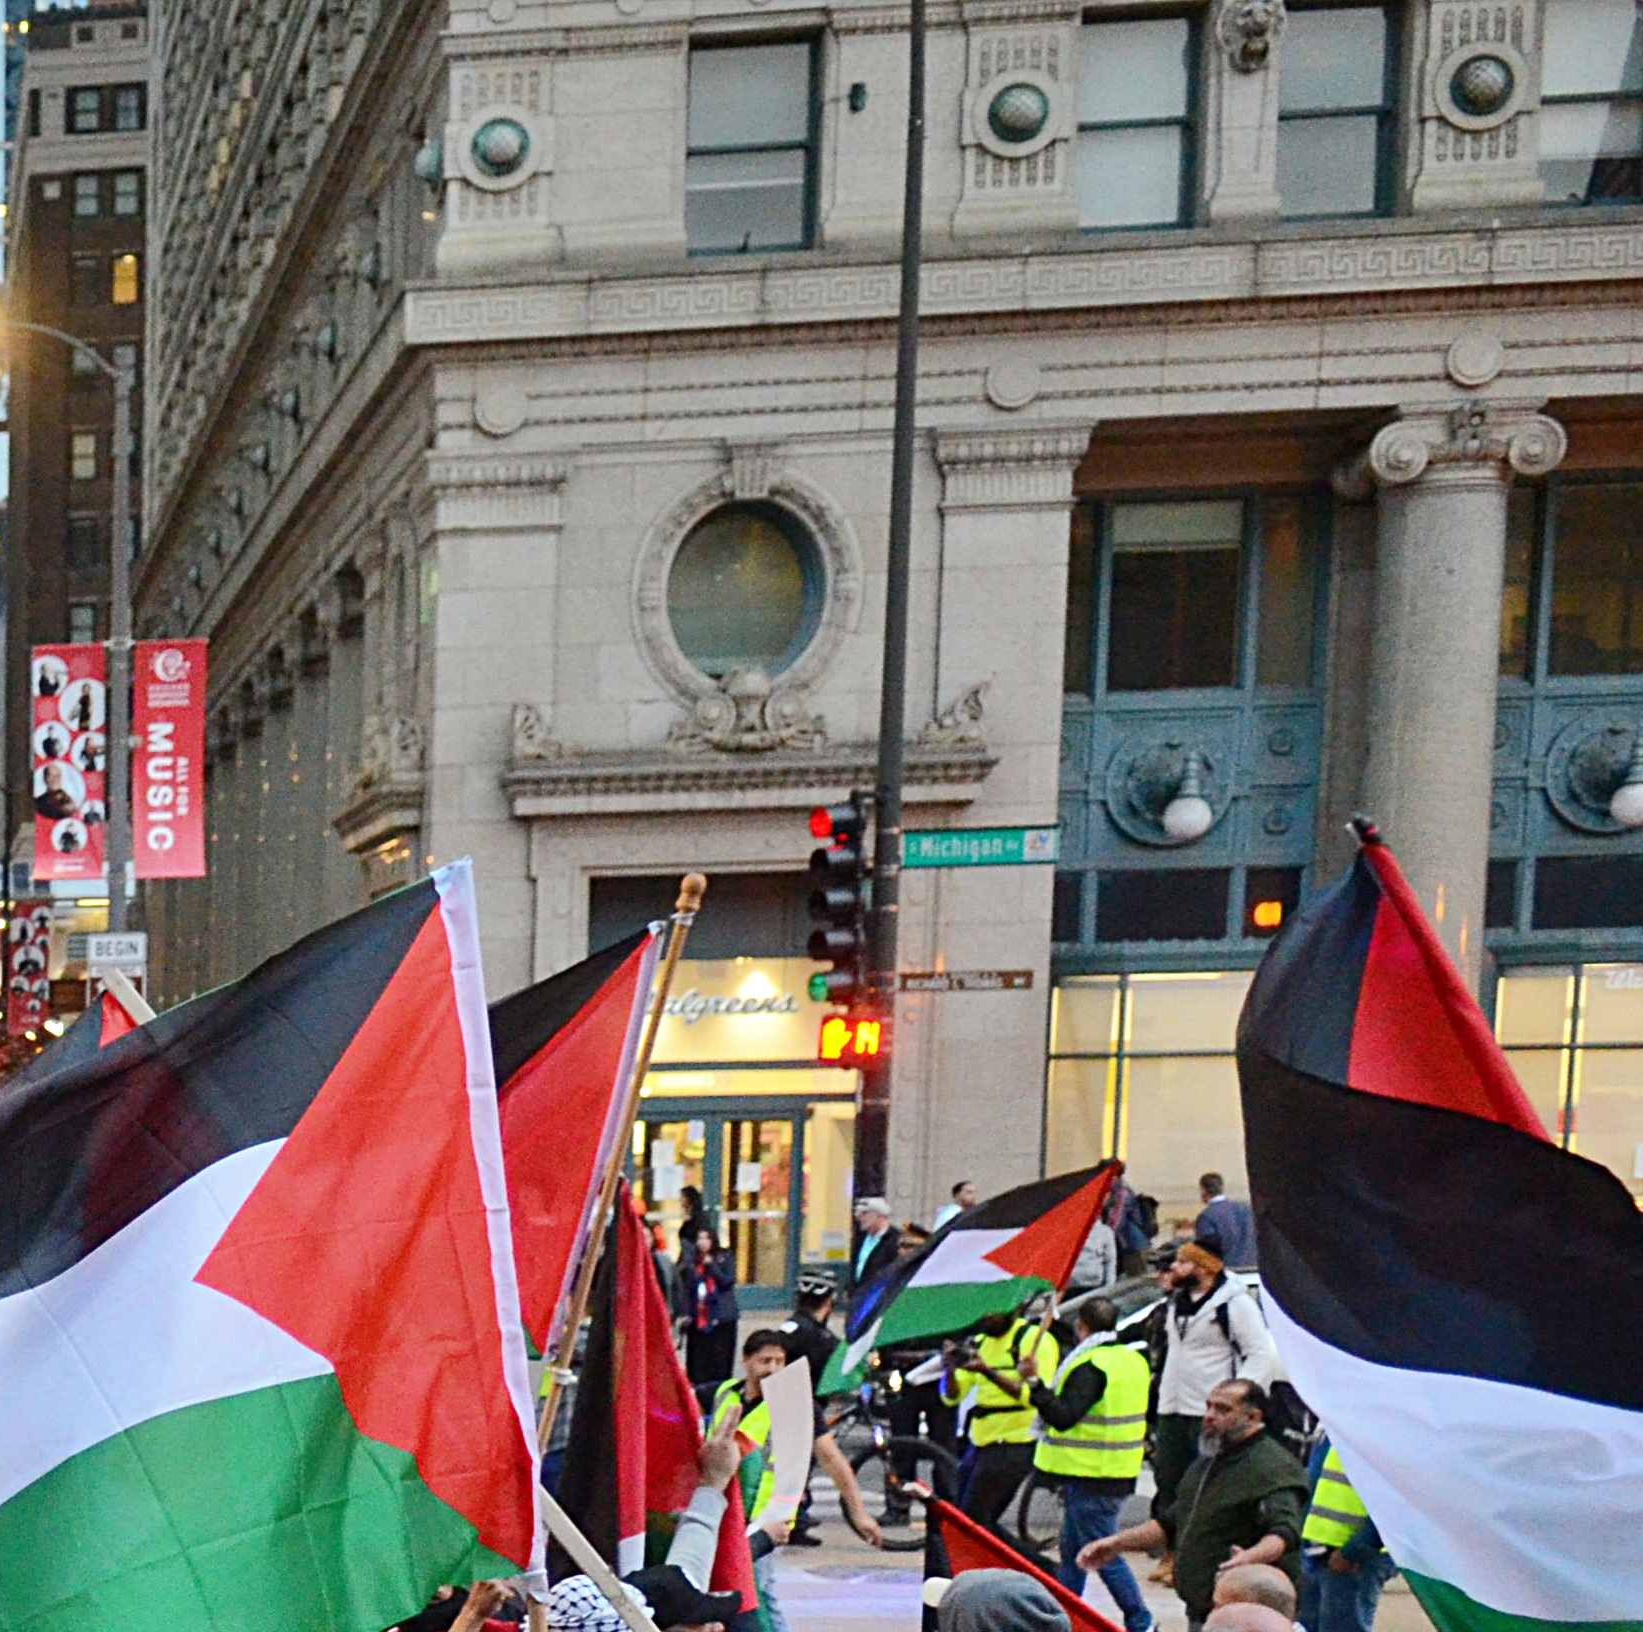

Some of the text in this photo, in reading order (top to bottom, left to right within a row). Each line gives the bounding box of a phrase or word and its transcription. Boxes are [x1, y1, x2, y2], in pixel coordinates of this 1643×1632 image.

[147, 721, 175, 851] MUSIC
[920, 834, 1003, 863] Michigan
[95, 941, 139, 957] BEGIN
[646, 987, 801, 1025] algreens
